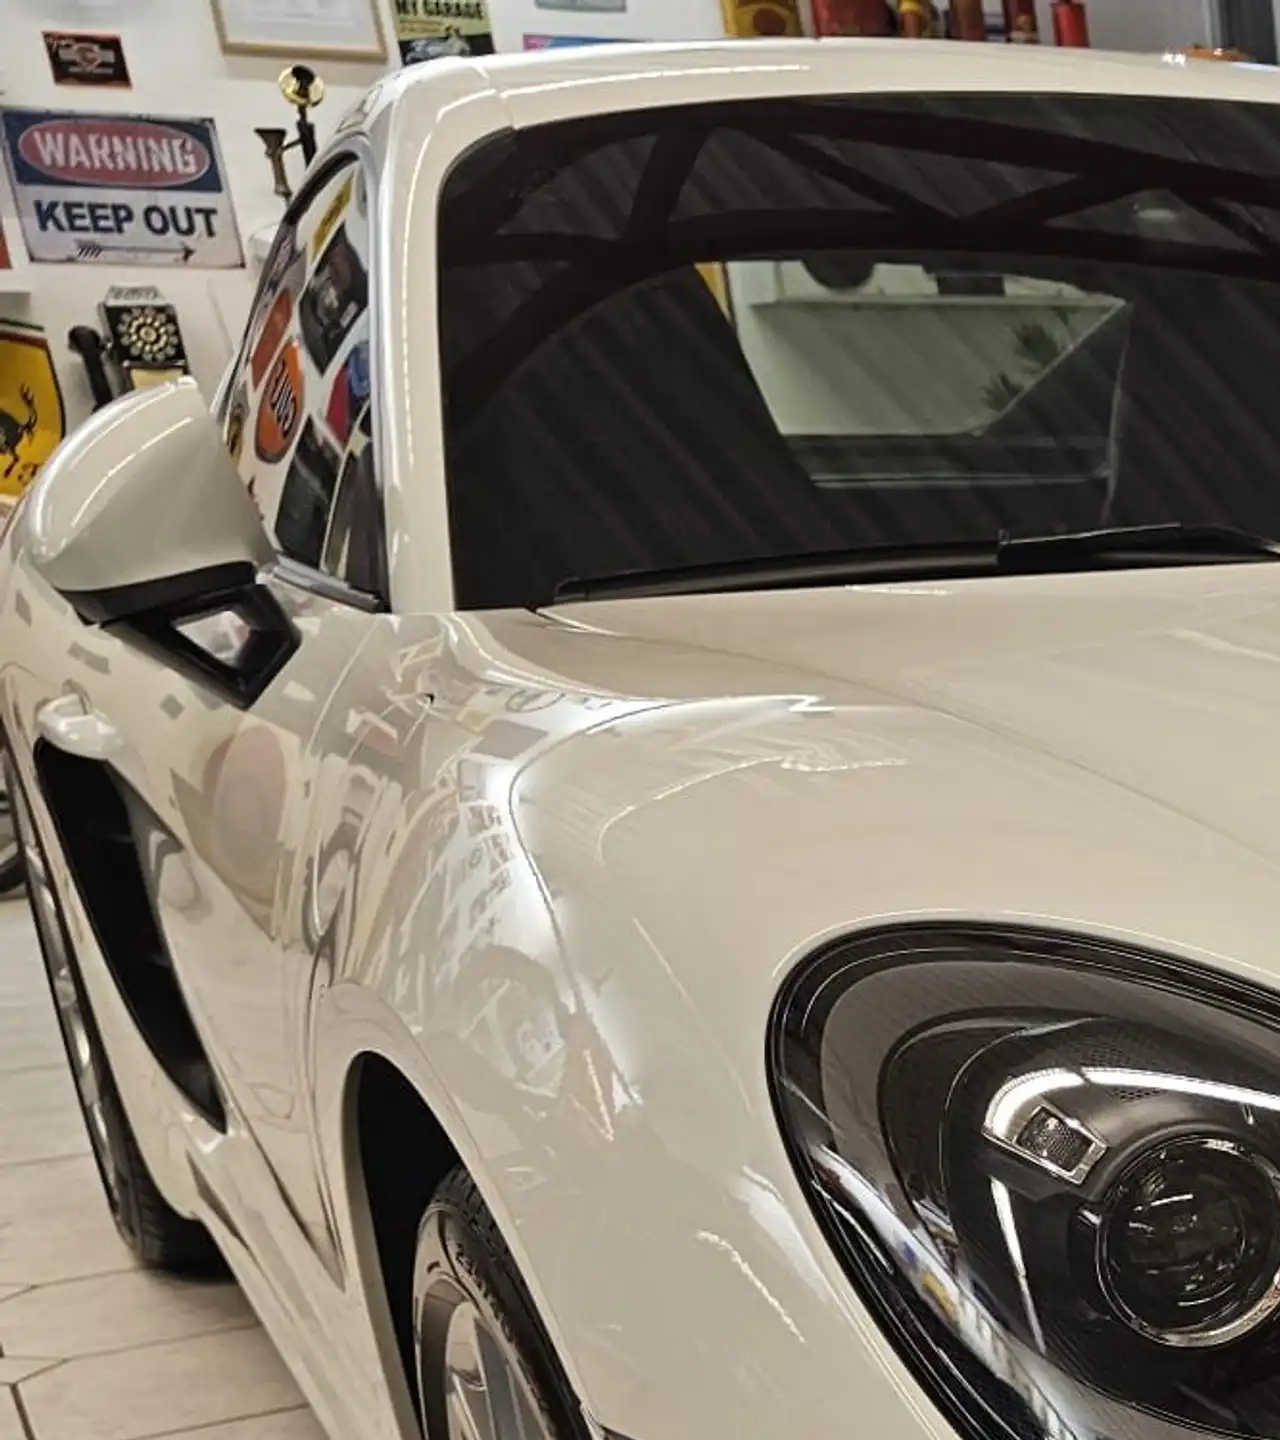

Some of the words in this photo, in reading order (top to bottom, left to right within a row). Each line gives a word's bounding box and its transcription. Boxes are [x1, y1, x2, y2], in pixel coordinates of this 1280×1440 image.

[34, 131, 199, 174] WARNING
[33, 201, 134, 234] KEEP
[143, 204, 217, 238] OUT
